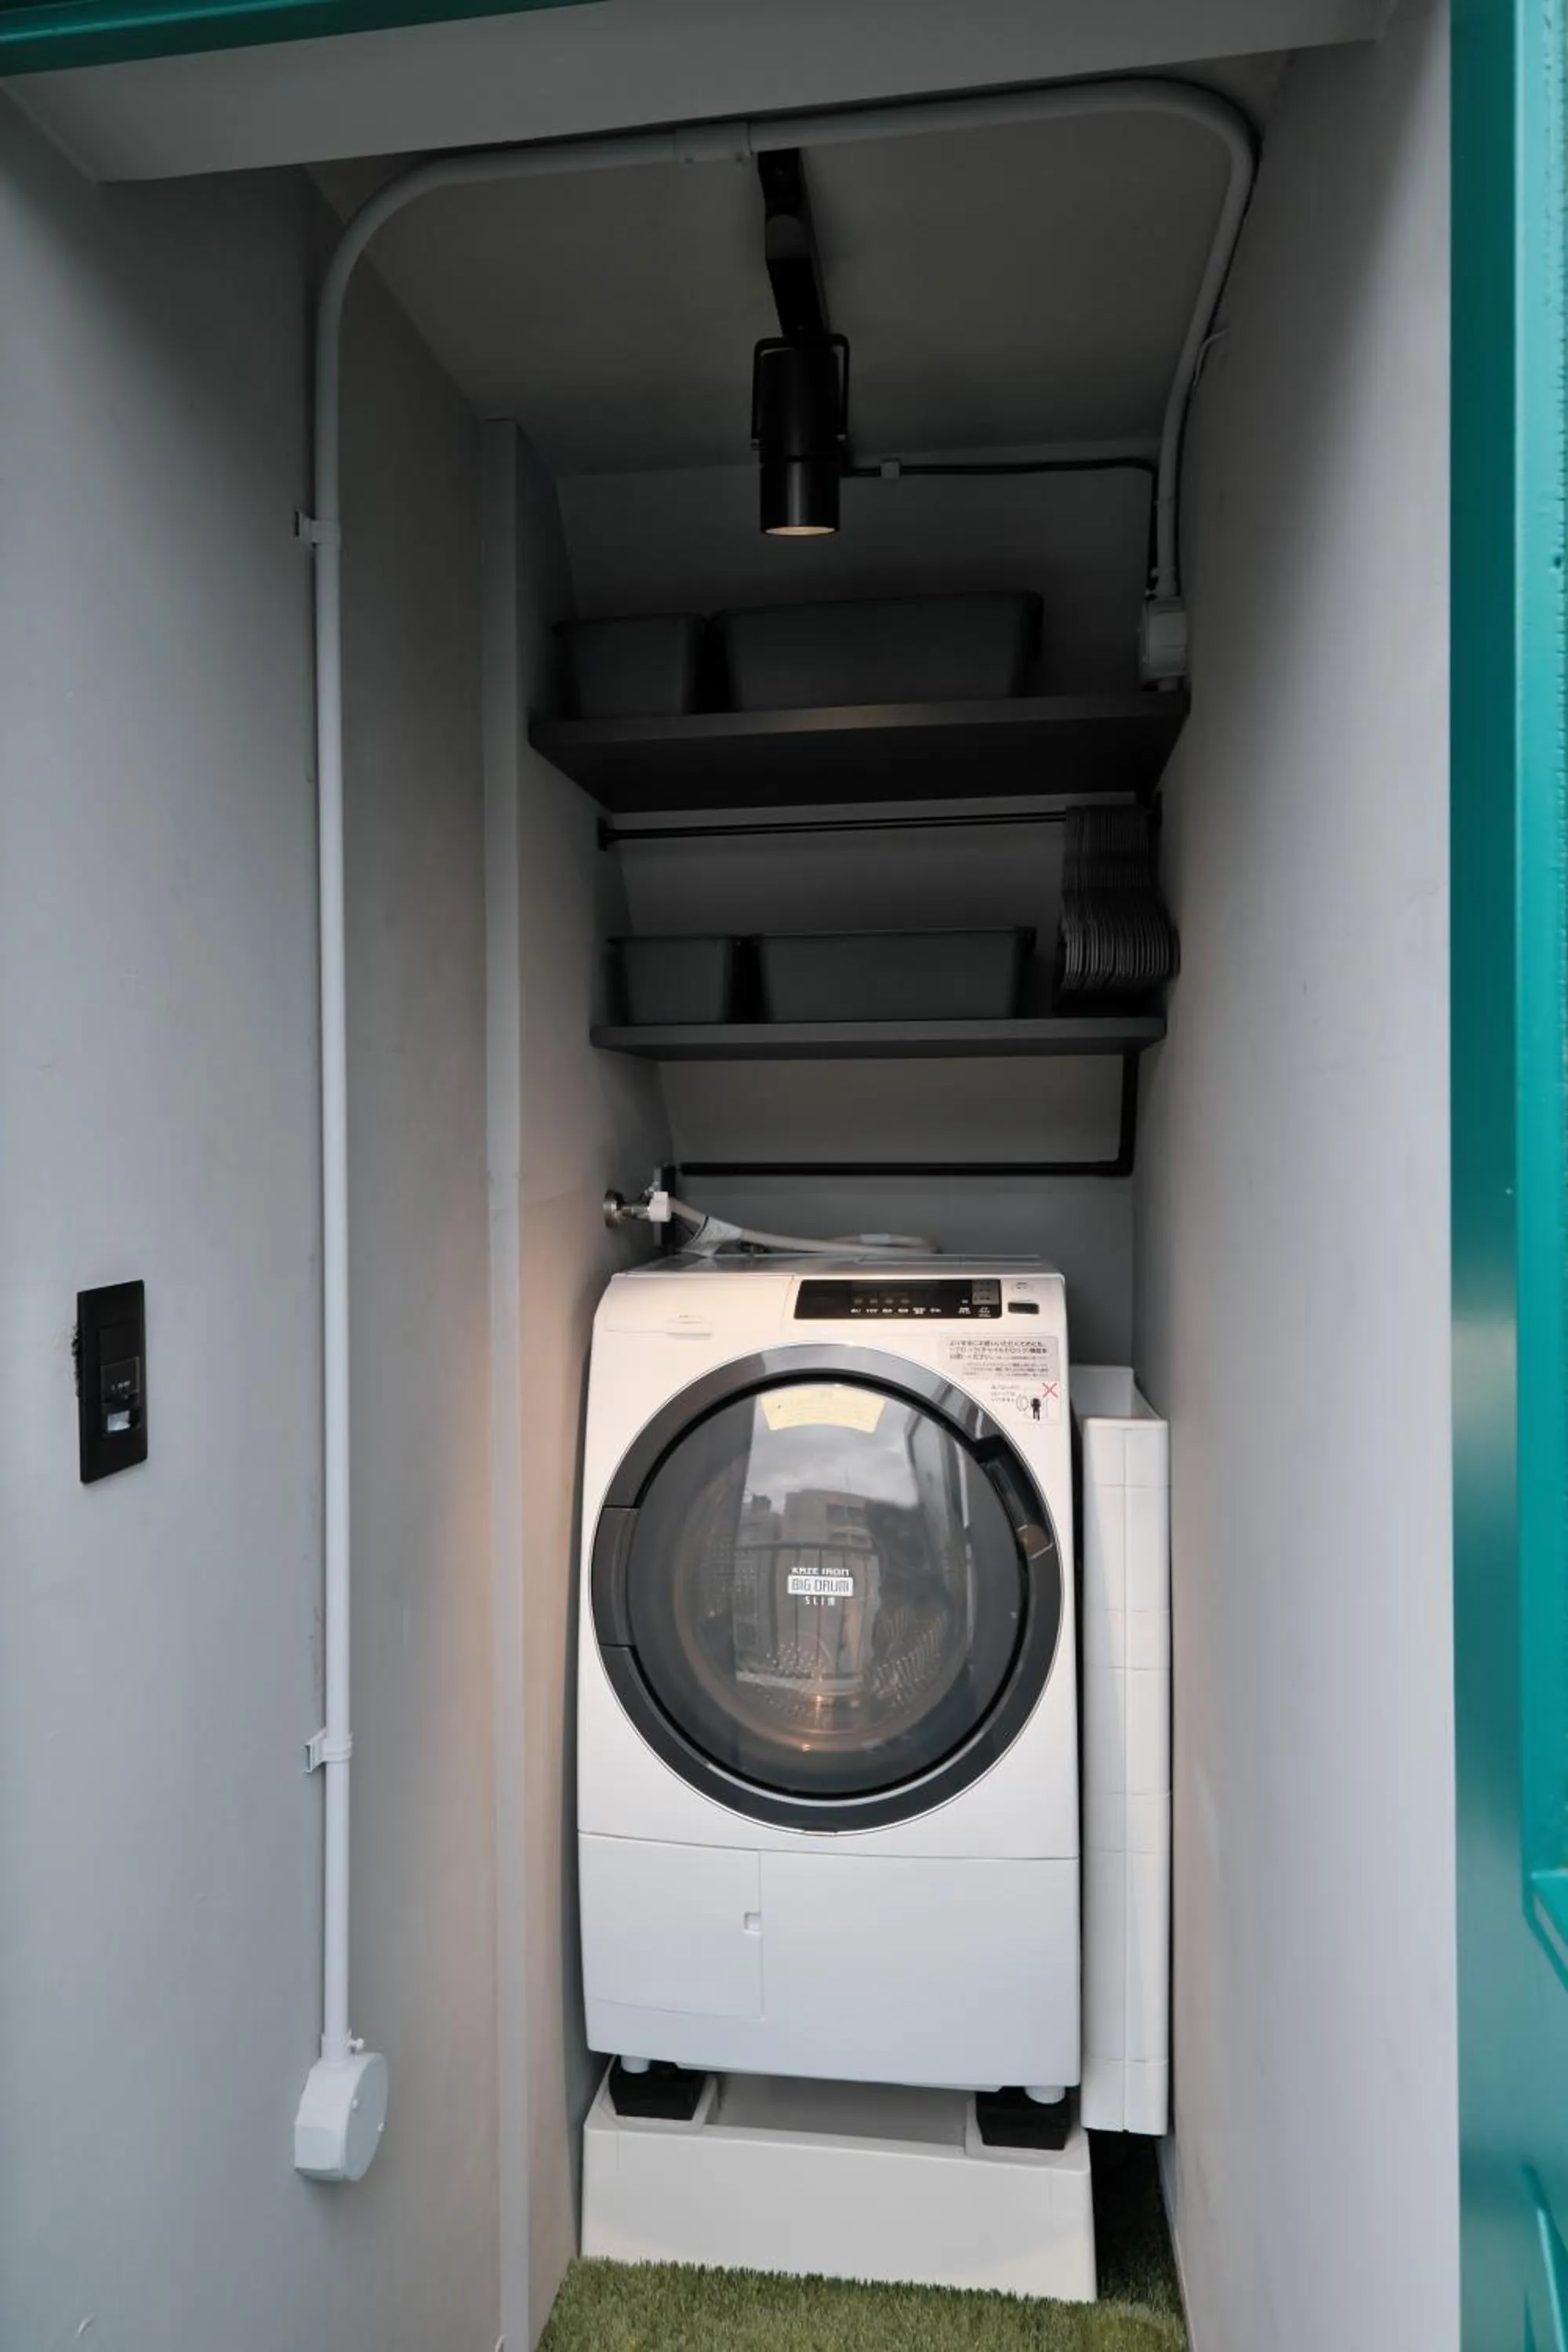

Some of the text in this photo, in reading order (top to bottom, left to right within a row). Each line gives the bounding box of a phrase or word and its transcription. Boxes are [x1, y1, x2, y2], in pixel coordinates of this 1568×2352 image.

[792, 1578, 850, 1593] BIG DRUM
[804, 1595, 836, 1606] SLIM
